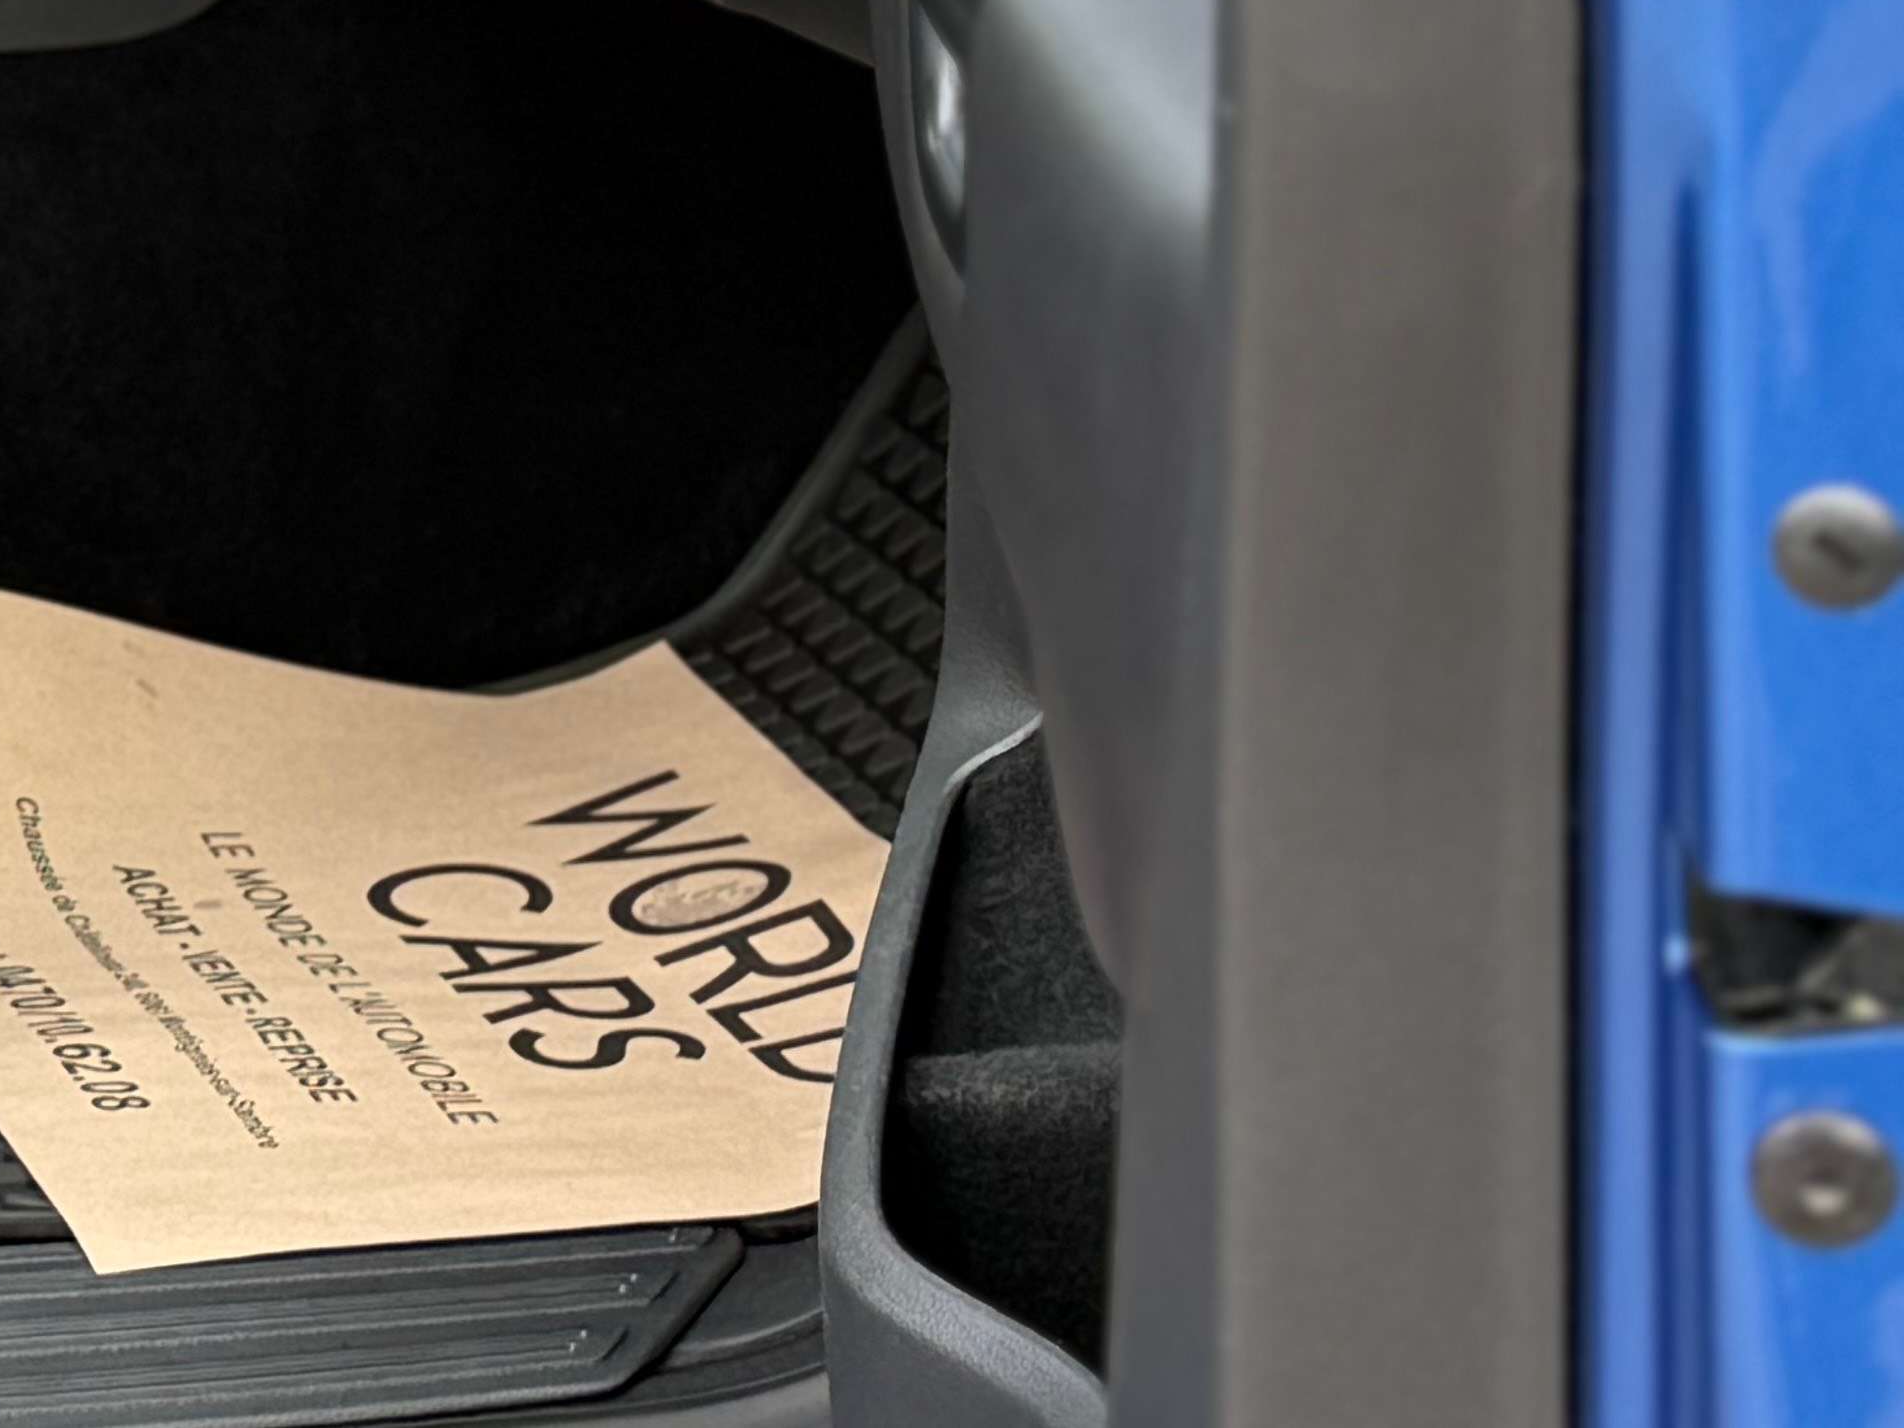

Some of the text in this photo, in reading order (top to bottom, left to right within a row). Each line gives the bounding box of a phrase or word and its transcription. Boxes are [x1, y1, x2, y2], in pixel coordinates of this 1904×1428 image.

[112, 864, 202, 937] ACHAT
[181, 949, 269, 1007] VENTE
[245, 1016, 359, 1103] REPRISE
[201, 831, 500, 1125] LE MONDE DE L'AUTOMOBILE
[366, 862, 707, 1070] CARS
[525, 769, 858, 1084] WORLD
